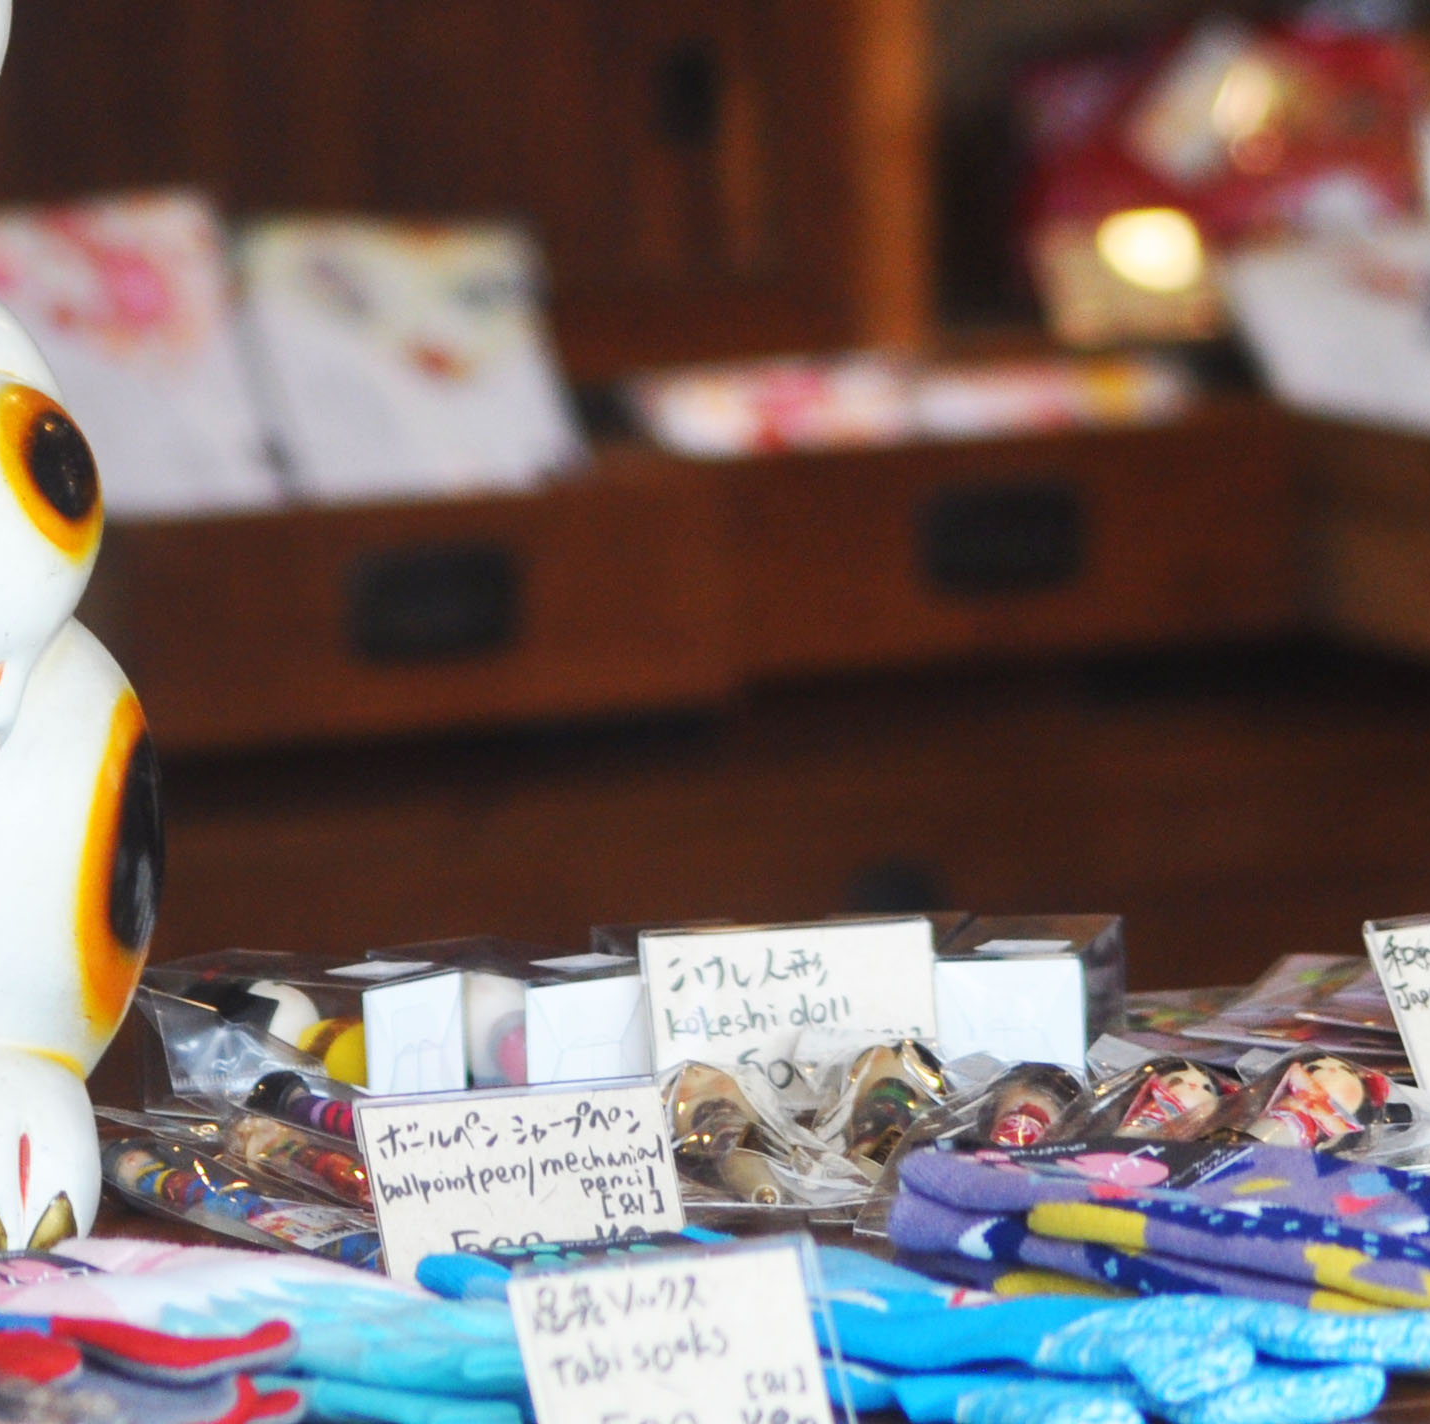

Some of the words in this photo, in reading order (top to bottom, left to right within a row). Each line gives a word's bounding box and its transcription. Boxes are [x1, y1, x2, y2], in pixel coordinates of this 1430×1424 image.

[667, 947, 828, 992] こけし人形
[665, 998, 778, 1041] kokeshi
[789, 993, 851, 1027] doll
[580, 1165, 656, 1198] pencil
